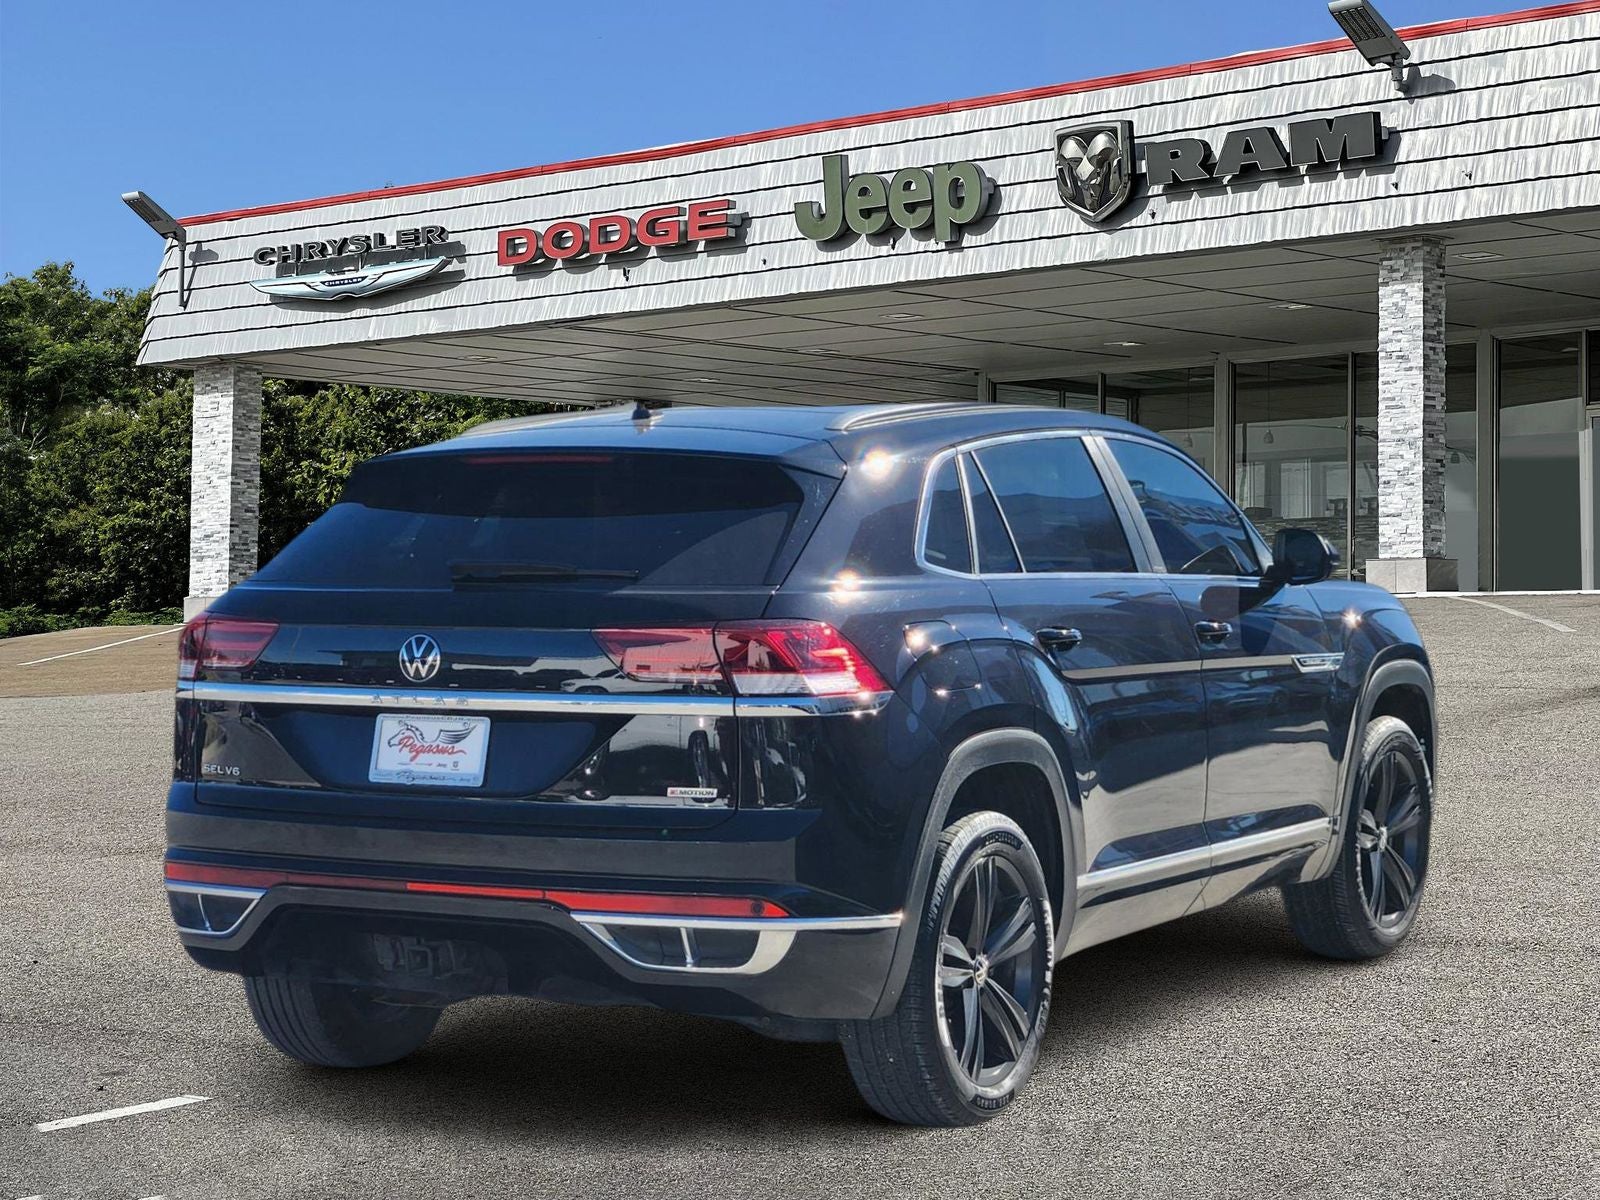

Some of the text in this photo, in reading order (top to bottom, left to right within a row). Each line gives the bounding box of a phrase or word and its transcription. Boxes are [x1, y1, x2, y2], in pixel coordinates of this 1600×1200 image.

[1145, 111, 1382, 187] RAM
[795, 155, 986, 243] Jeep
[253, 224, 448, 266] CHRYSLER
[498, 199, 736, 267] DODGE
[324, 277, 363, 286] CHRYSLER
[398, 735, 467, 762] Pegasus
